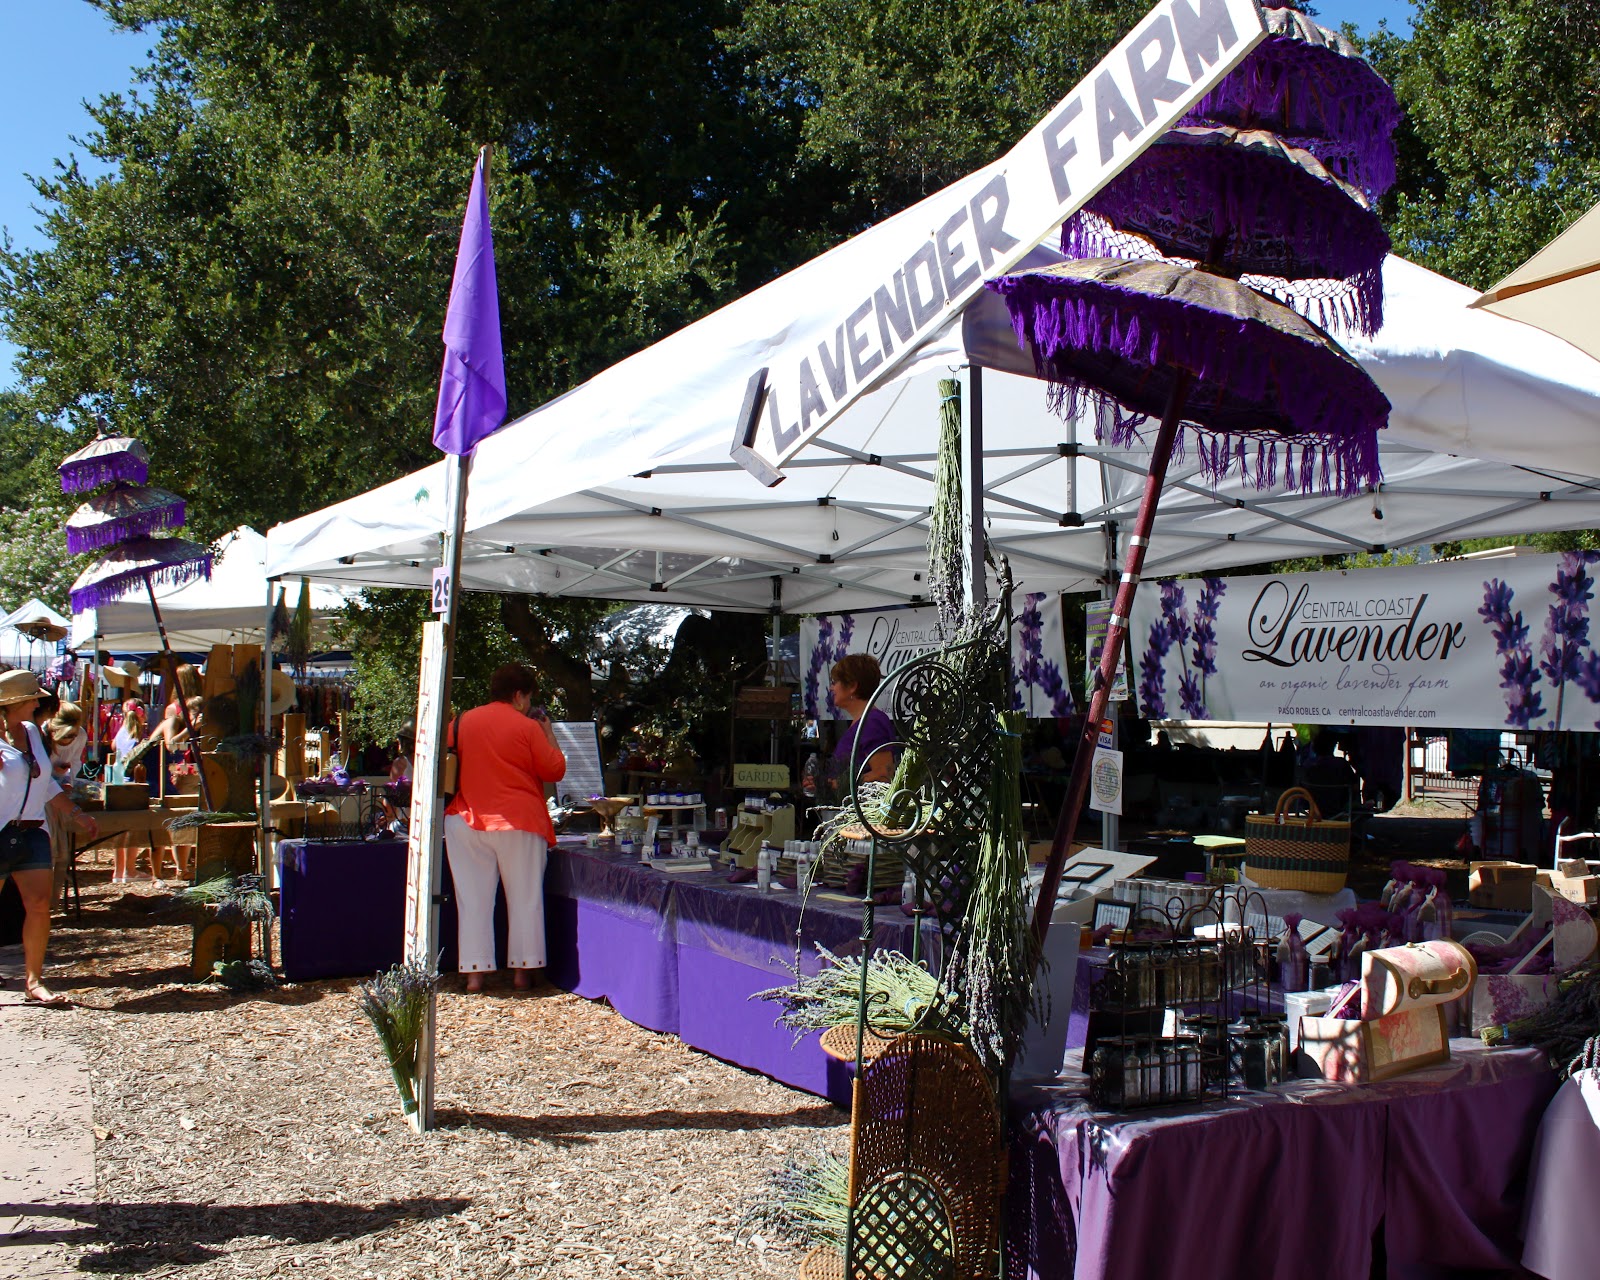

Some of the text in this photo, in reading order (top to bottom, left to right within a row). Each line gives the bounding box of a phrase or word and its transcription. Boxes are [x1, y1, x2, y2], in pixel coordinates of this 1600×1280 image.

[768, 0, 1239, 456] LAVENDER FARM
[1302, 597, 1414, 619] CENTRAL COAST
[1241, 580, 1466, 667] Lavender
[895, 627, 953, 645] CENTRAL COST
[1259, 663, 1450, 710] an organic lavender farm
[1278, 706, 1295, 715] PASO
[1321, 708, 1331, 716] CA
[1338, 705, 1436, 718] centralcoastlavender.com
[1099, 734, 1112, 745] VISA
[737, 769, 785, 783] GARDEN
